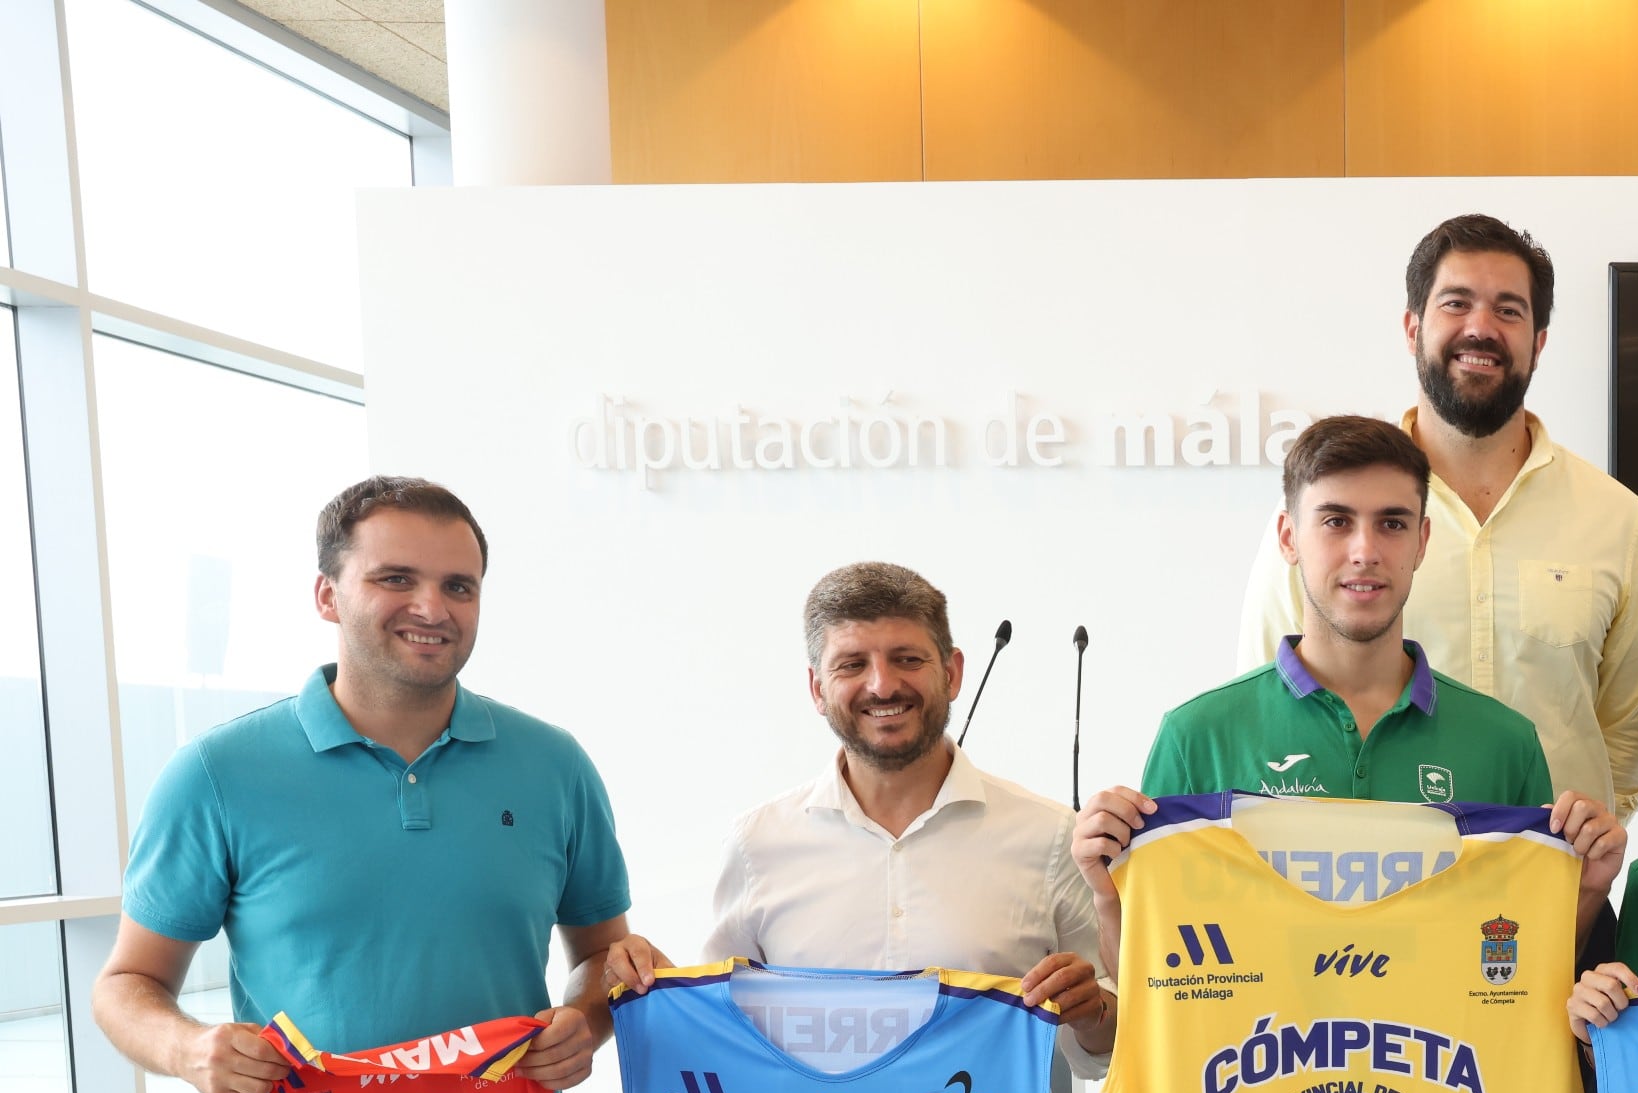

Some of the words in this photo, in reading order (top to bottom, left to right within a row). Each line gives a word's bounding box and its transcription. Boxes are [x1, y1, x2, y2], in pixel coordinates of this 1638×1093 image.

[569, 391, 948, 490] diputación
[981, 388, 1067, 468] de
[1111, 388, 1313, 467] mála
[1258, 777, 1330, 796] Andalucía
[1147, 973, 1205, 989] Diputación
[1207, 972, 1264, 985] Provincial
[1174, 990, 1189, 1001] de
[1191, 987, 1234, 1001] Málaga
[474, 1079, 489, 1090] de
